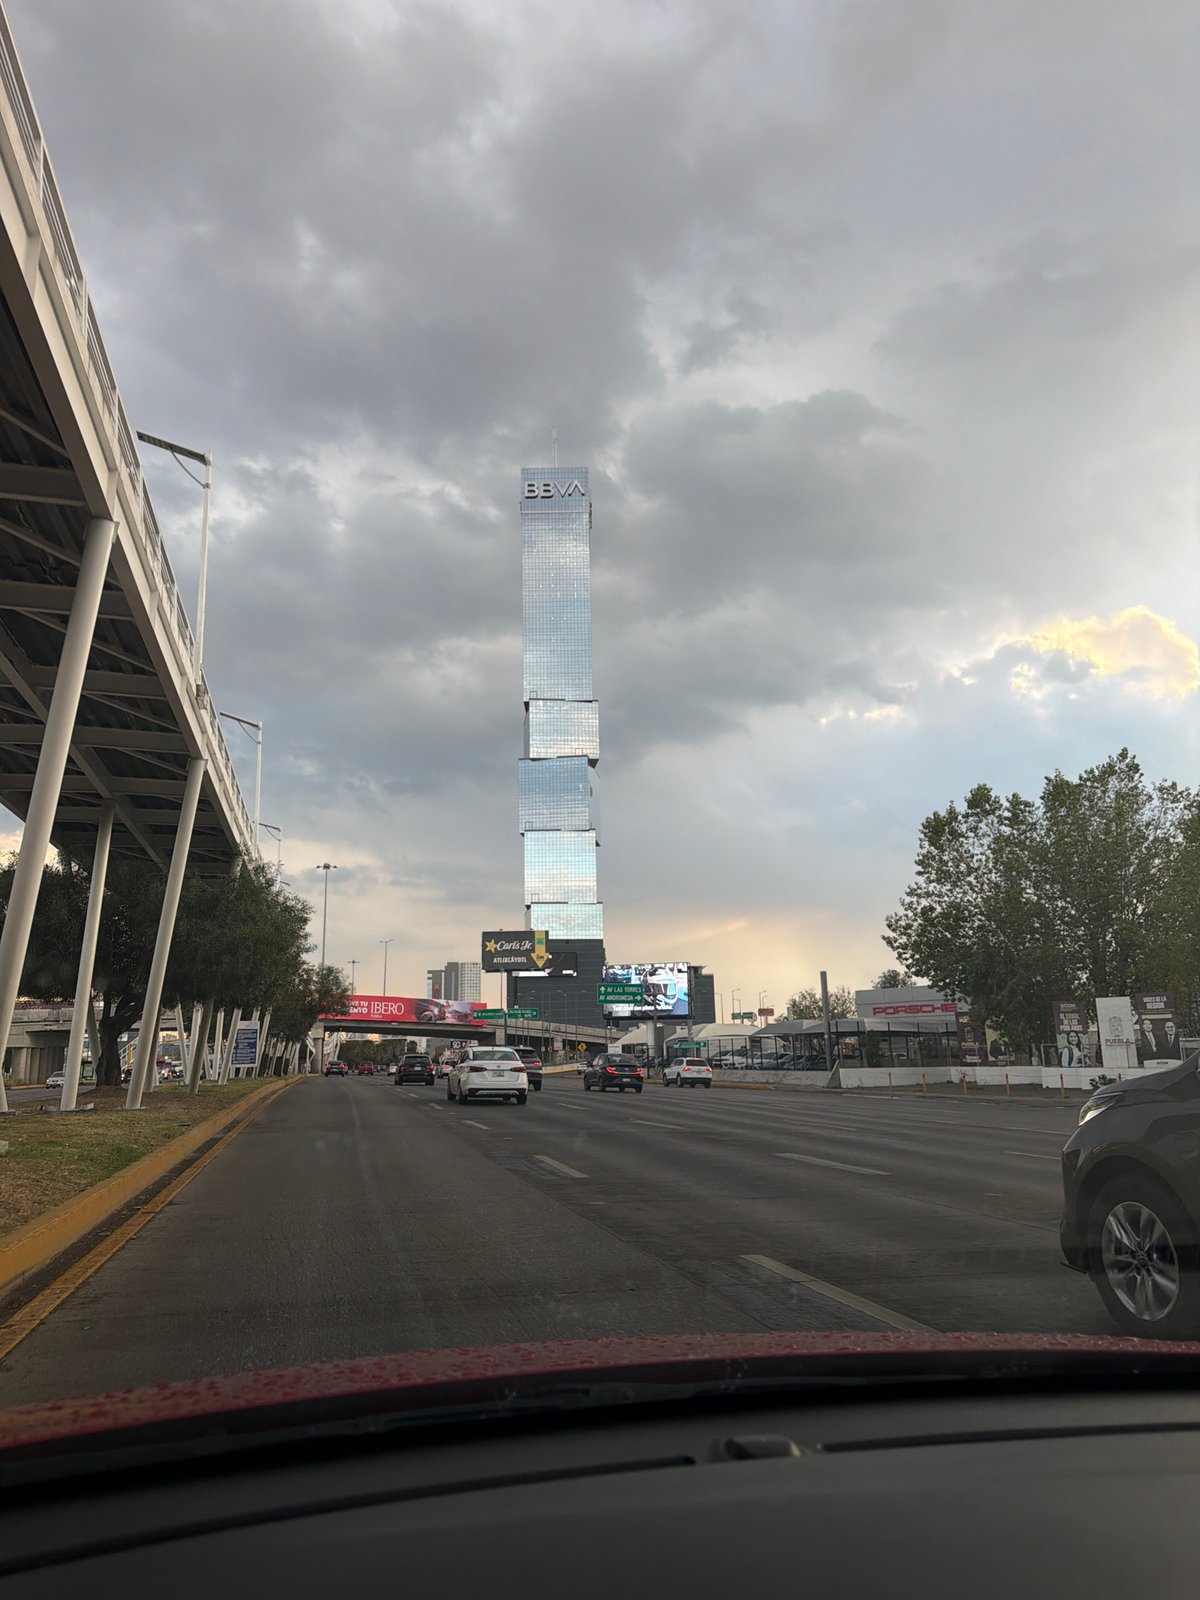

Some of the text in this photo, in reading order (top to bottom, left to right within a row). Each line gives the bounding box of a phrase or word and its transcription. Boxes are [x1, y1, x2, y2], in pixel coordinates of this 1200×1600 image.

[525, 480, 585, 499] BBVA
[497, 940, 520, 951] Carl's
[520, 940, 533, 951] Jr.
[371, 1001, 404, 1015] IBERO
[872, 1003, 958, 1016] PORSCHE
